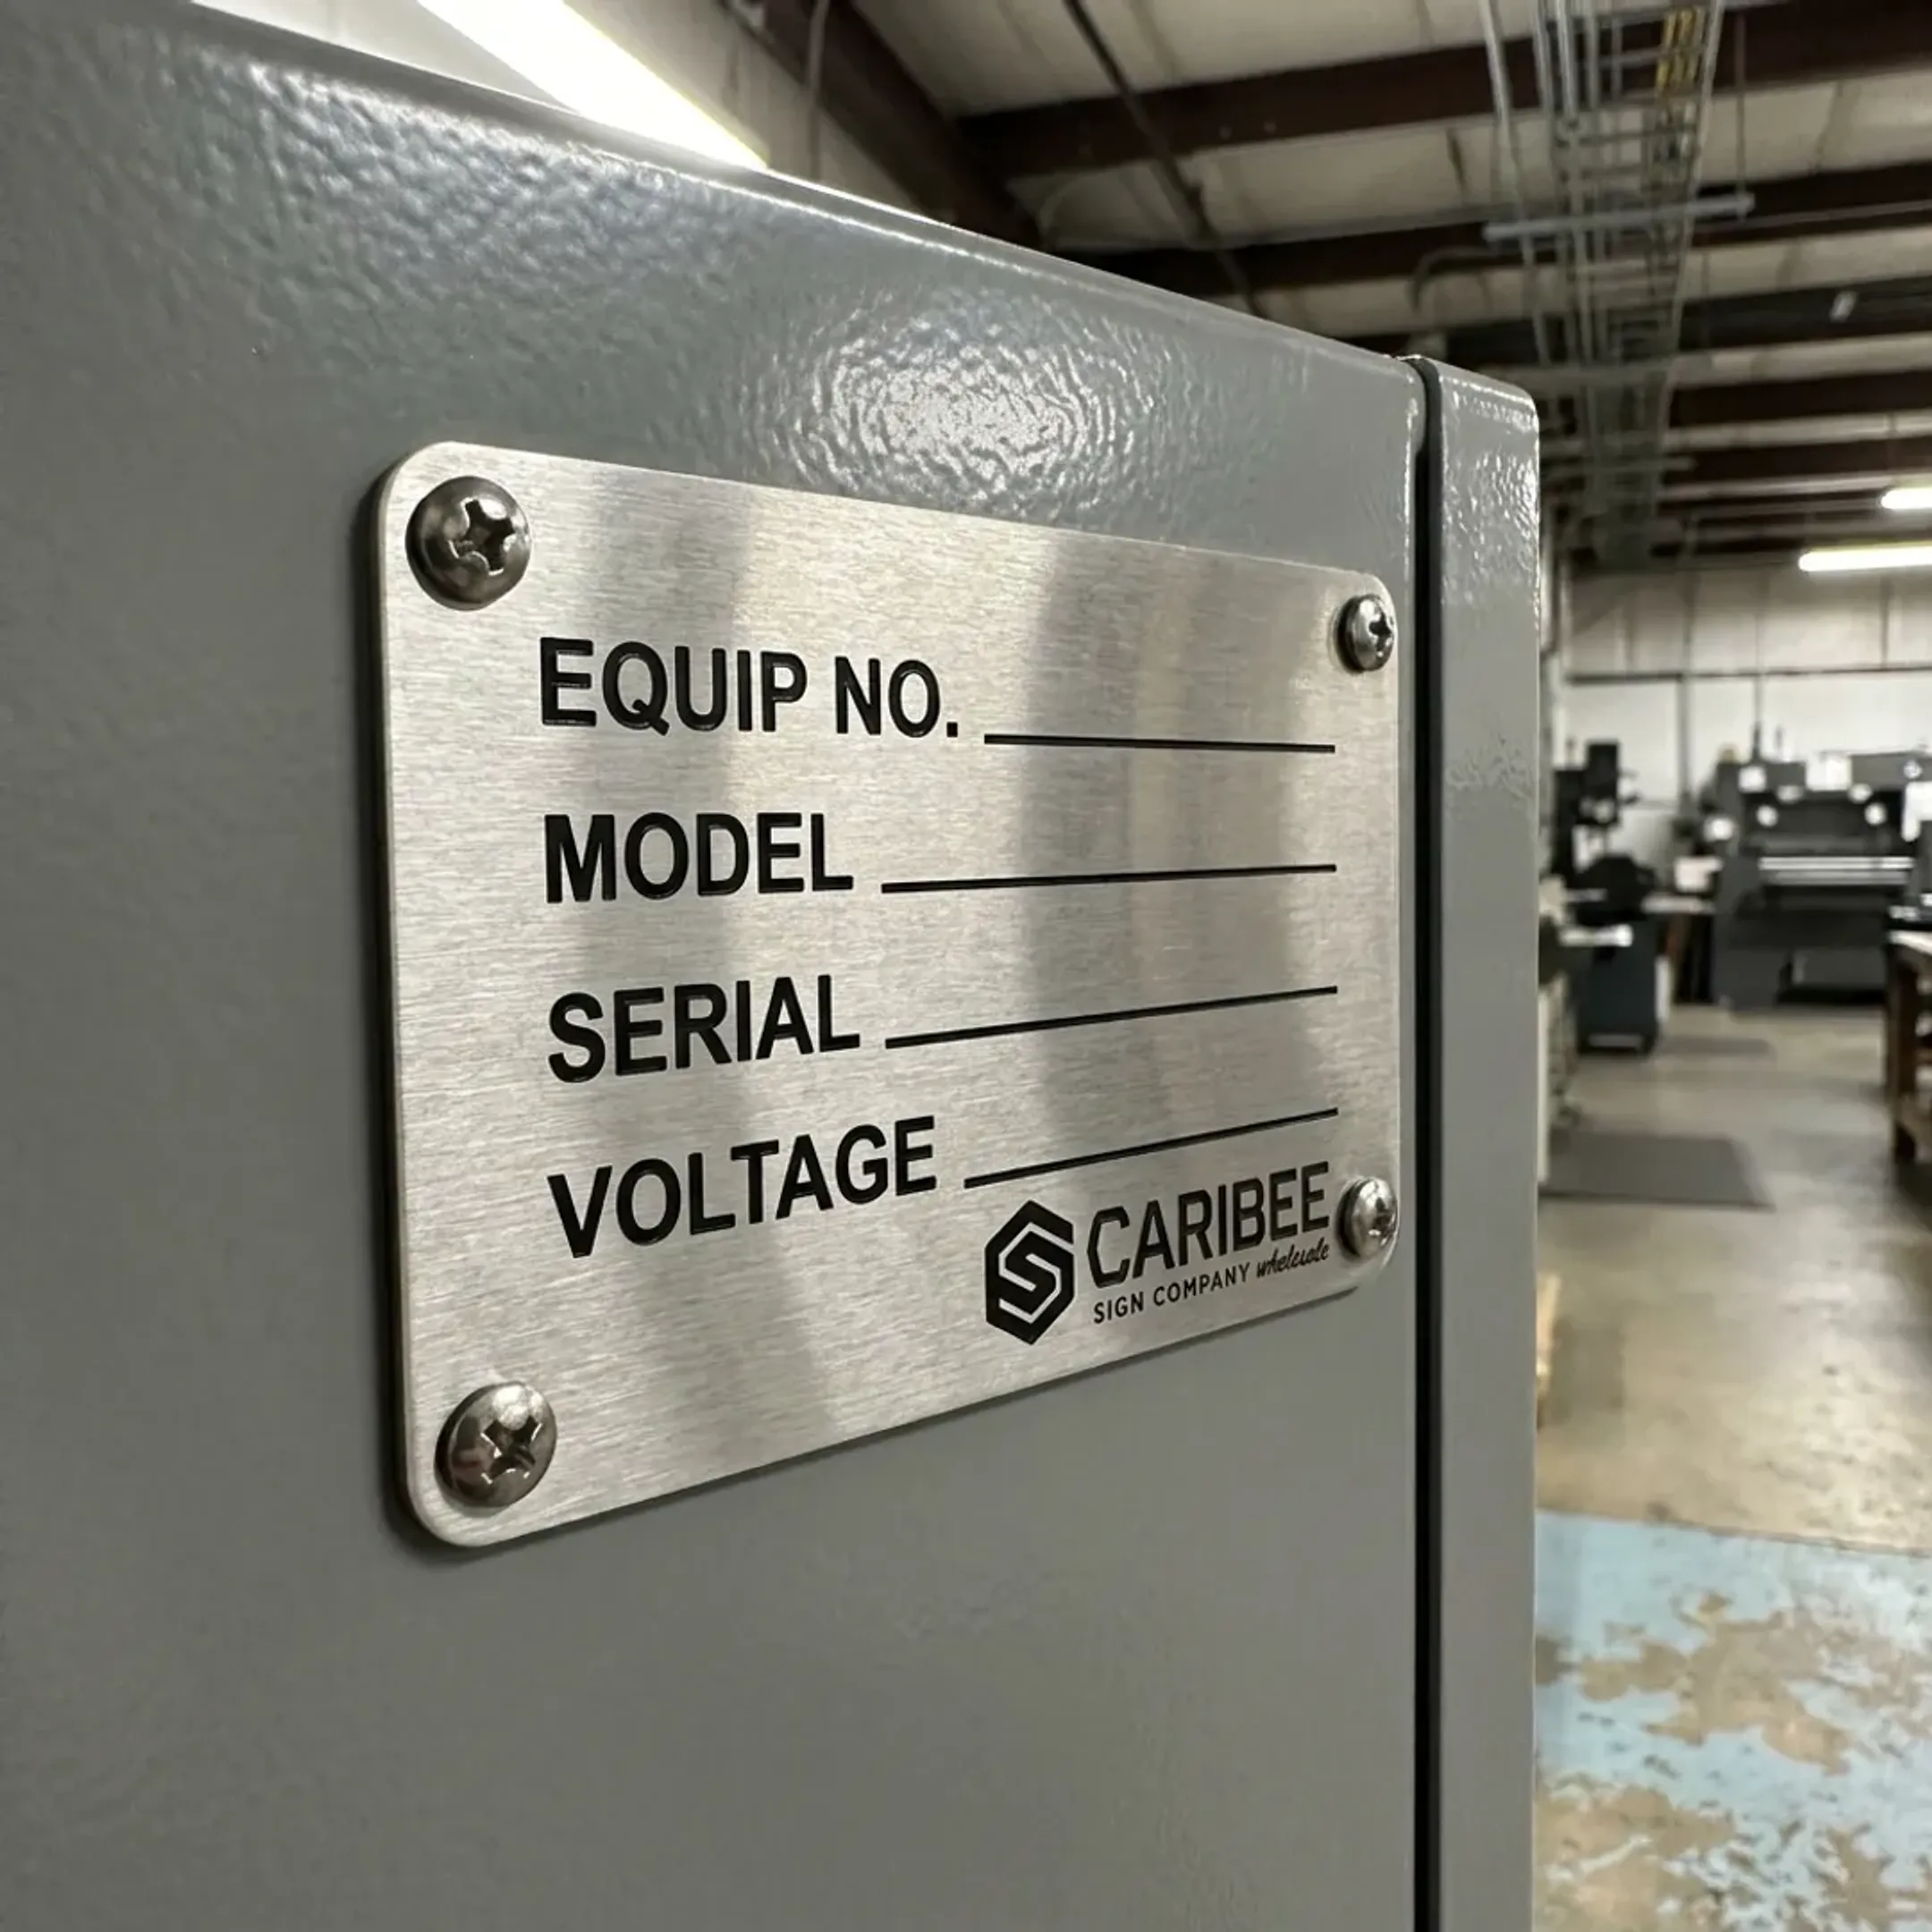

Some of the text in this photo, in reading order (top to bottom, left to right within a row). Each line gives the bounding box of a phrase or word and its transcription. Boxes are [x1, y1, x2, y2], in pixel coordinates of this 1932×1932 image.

[540, 637, 958, 738] EQUIP NO.
[544, 811, 854, 903] MODEL
[547, 974, 860, 1083] SERIAL
[547, 1115, 936, 1258] VOLTAGE
[1086, 1160, 1330, 1289] CARIBEE
[1092, 1291, 1145, 1325] SIGN
[1152, 1261, 1250, 1307] COMPANY
